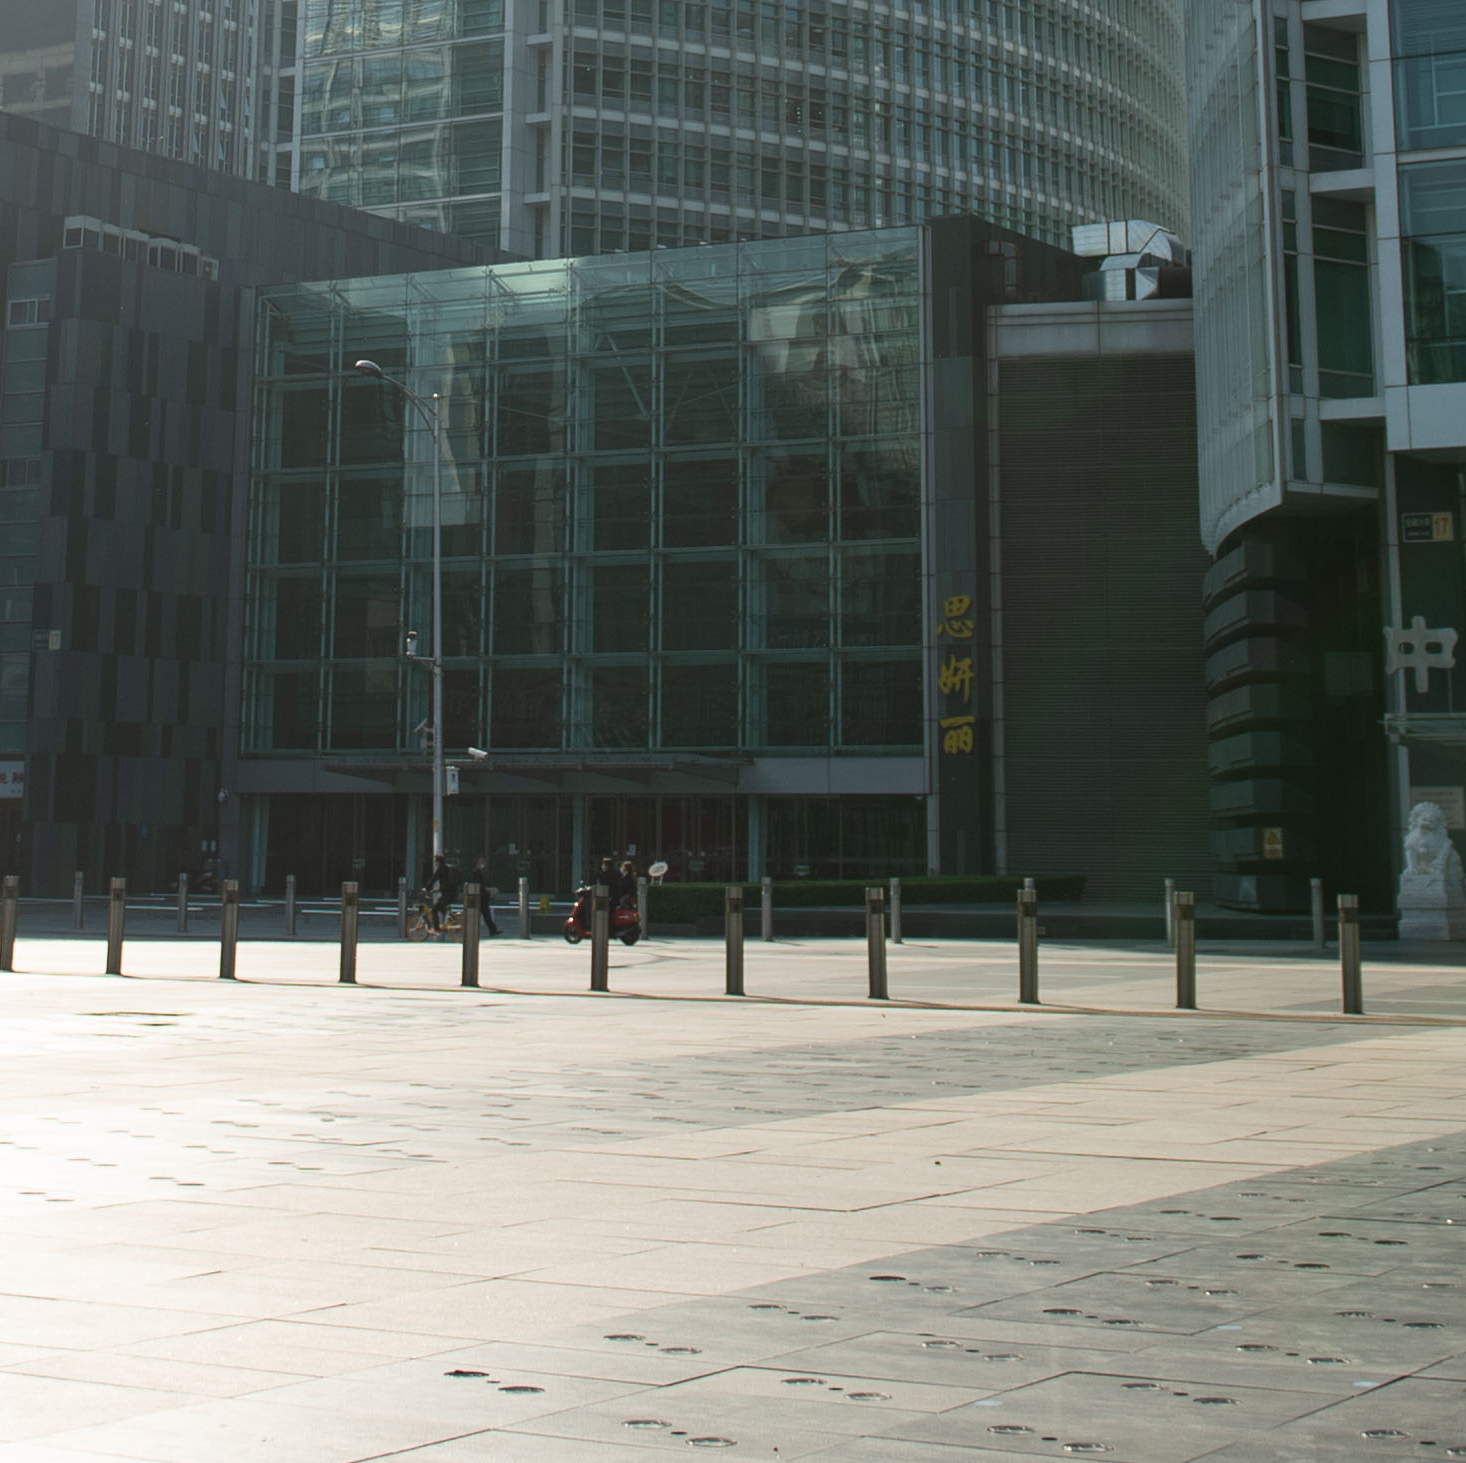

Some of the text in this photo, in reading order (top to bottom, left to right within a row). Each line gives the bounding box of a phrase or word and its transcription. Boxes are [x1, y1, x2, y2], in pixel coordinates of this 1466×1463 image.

[1434, 516, 1450, 537] 17
[936, 594, 975, 755] 思妍丽
